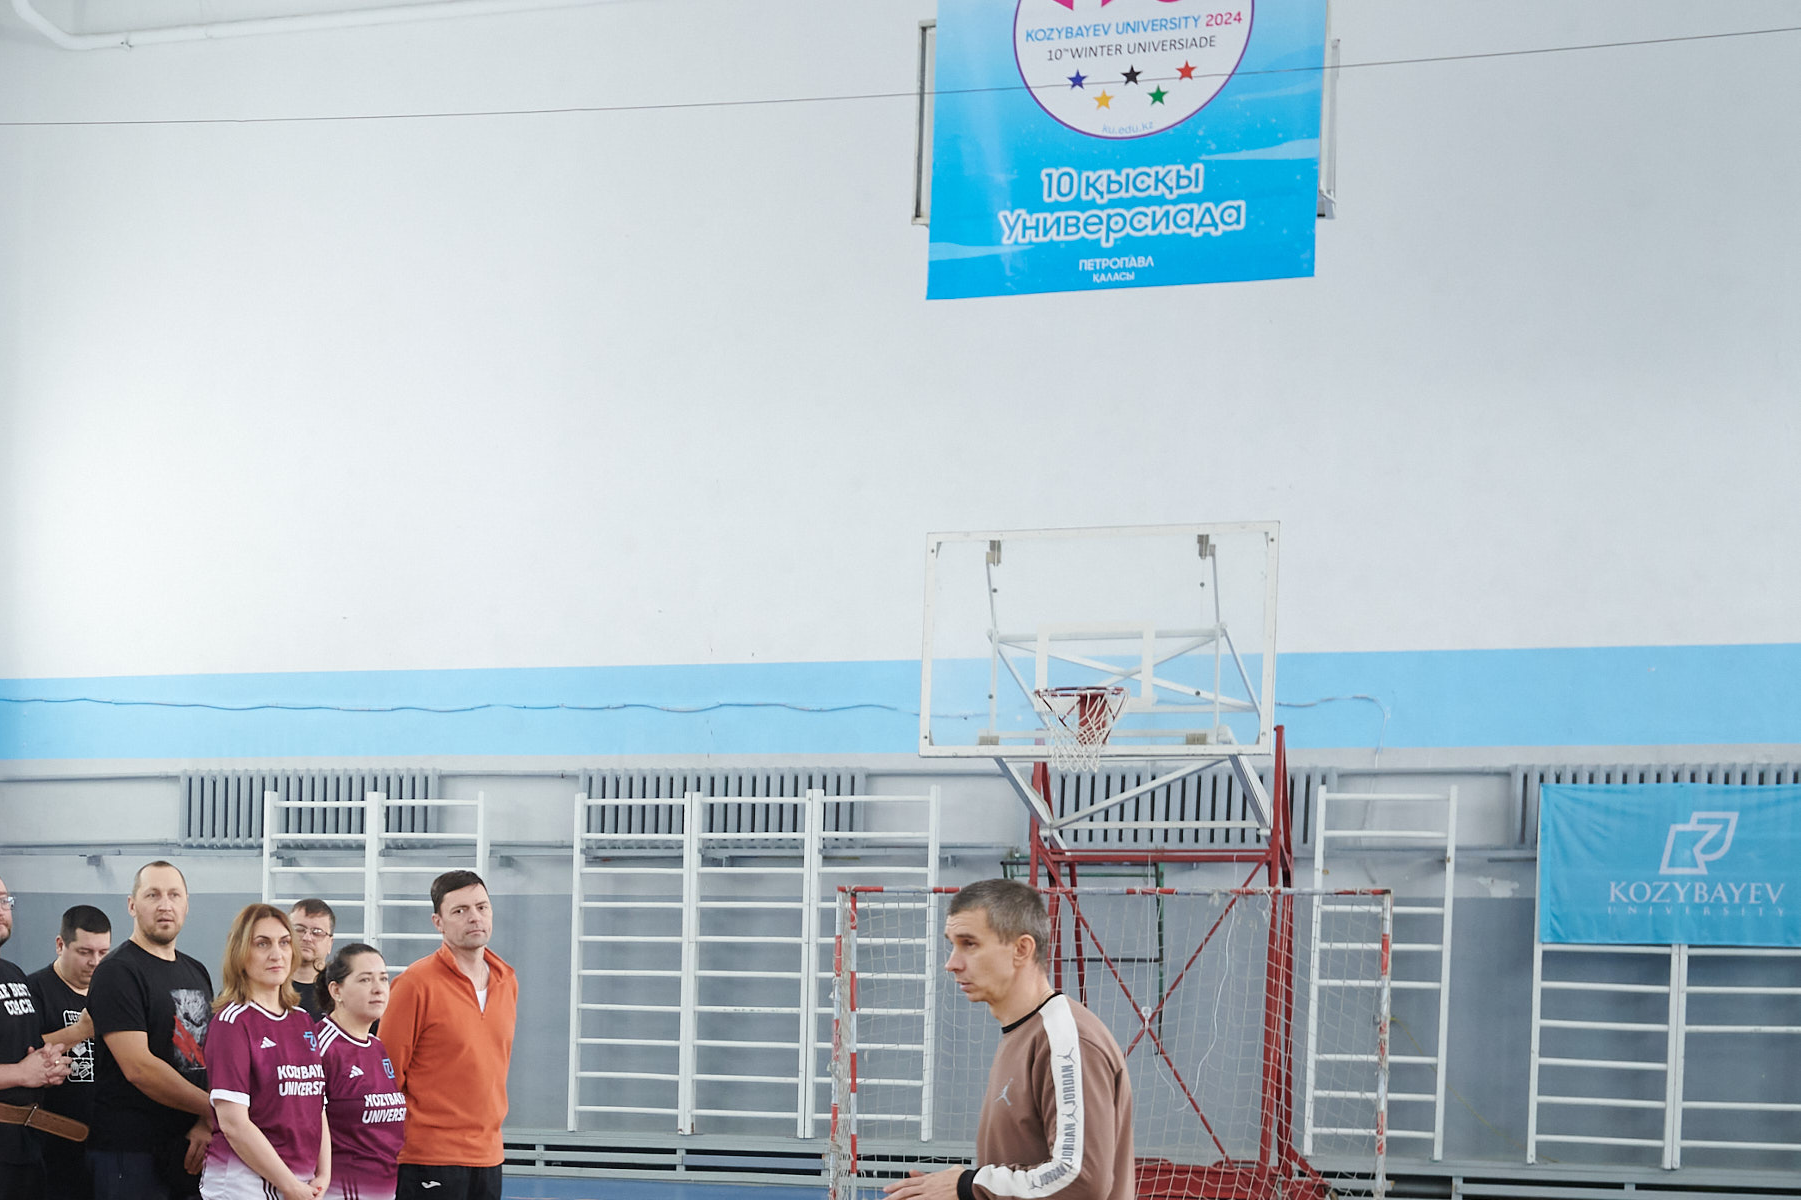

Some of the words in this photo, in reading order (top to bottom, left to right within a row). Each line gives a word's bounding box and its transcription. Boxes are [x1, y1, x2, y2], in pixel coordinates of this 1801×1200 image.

[1025, 22, 1112, 42] KOZYBAYEV
[1115, 15, 1202, 35] UNIVERSITY
[1205, 11, 1243, 27] 2024
[1069, 43, 1123, 60] WINTER
[1127, 35, 1217, 55] UNIVERSIADE
[1041, 166, 1077, 203] 10
[999, 200, 1247, 248] Универсиада
[1078, 255, 1155, 272] ПЕТРОПАВЛ
[1609, 881, 1786, 905] KOZYBAYEV
[1607, 905, 1785, 917] UNIVERSITY
[3, 998, 36, 1016] COACH
[1061, 1064, 1076, 1106] JORDAN
[1061, 1123, 1076, 1162] JORDAN
